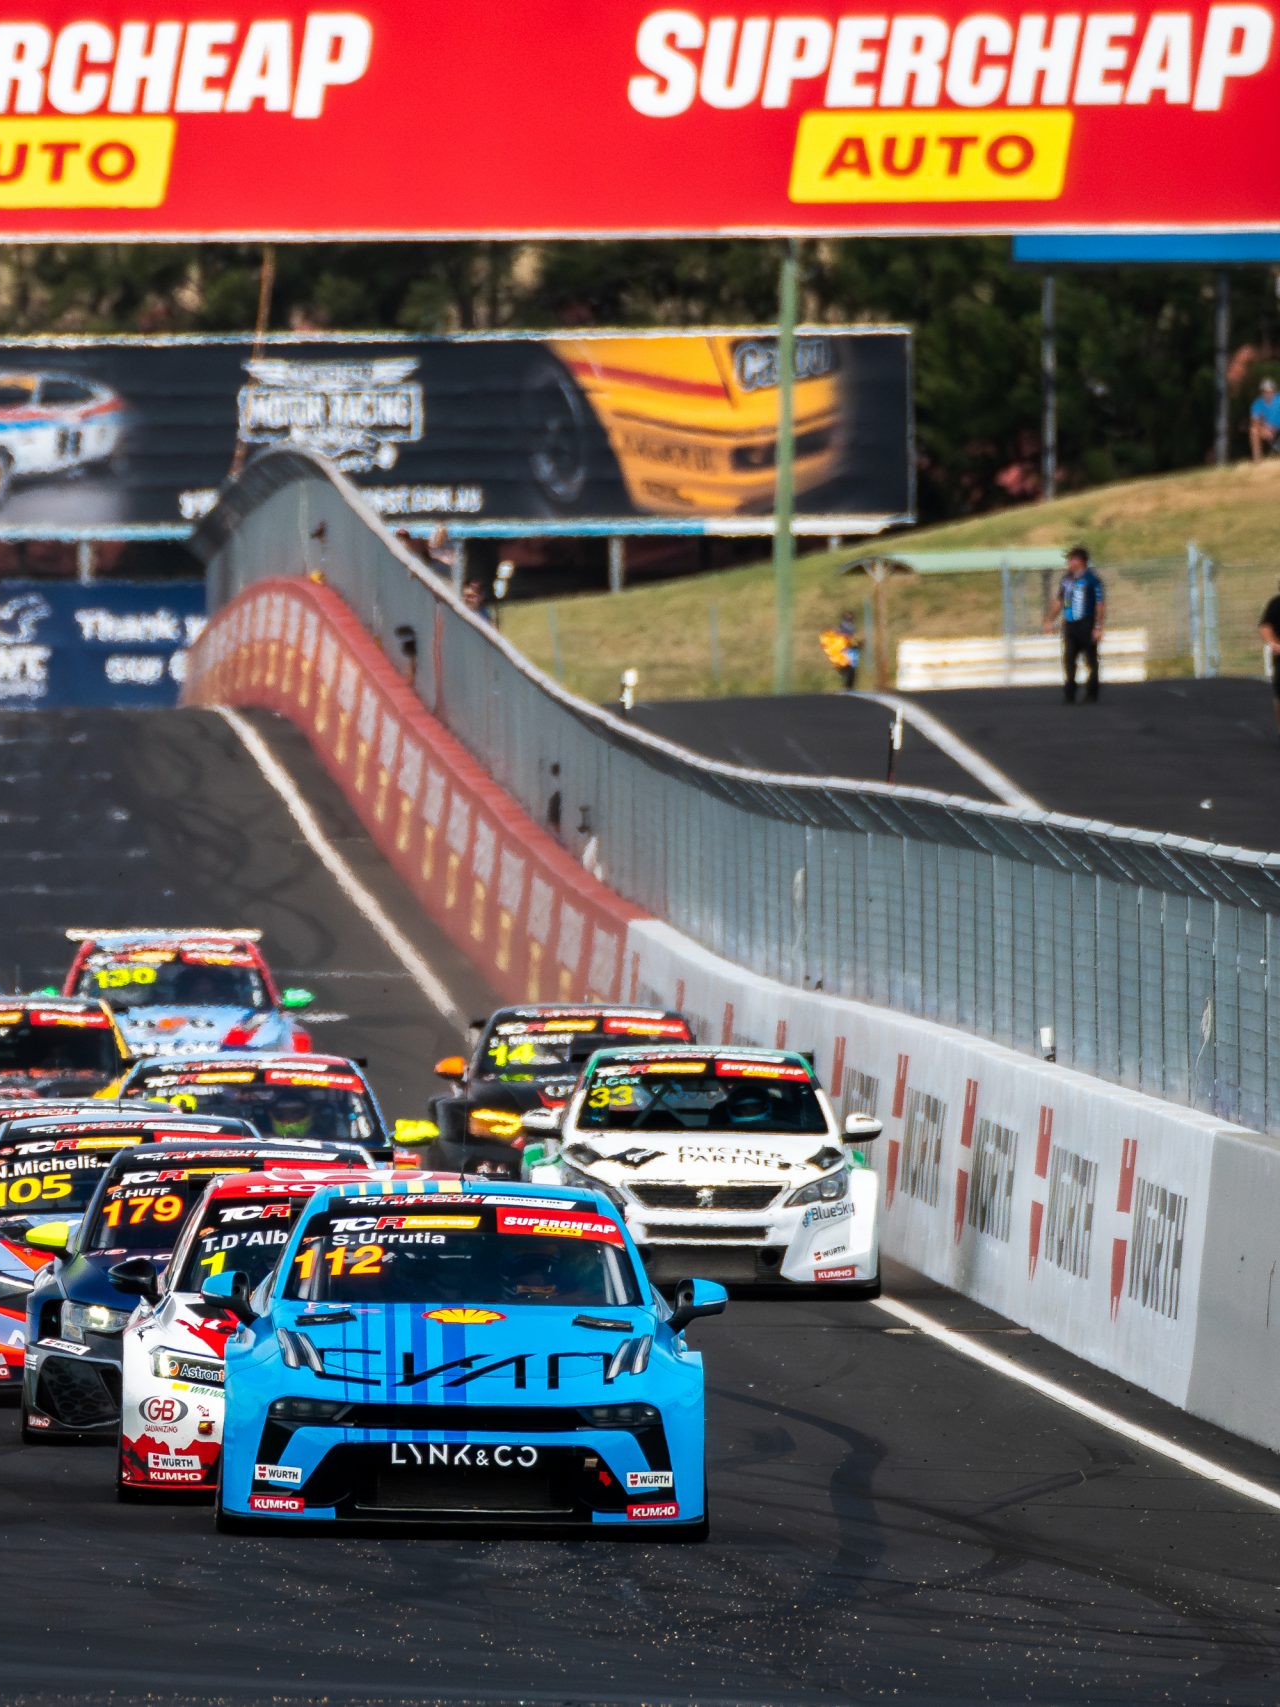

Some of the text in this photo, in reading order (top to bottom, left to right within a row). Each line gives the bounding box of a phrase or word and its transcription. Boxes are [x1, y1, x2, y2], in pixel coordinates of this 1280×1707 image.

[627, 4, 1272, 117] SUPERCHEAP
[824, 134, 1034, 178] AUTO
[488, 1043, 536, 1067] 14
[588, 1085, 633, 1108] 33
[15, 1139, 80, 1155] TCR
[678, 1145, 784, 1160] PITCHER
[120, 1169, 187, 1185] TCR
[112, 1188, 171, 1200] R.HUFF
[102, 1195, 184, 1228] 179
[219, 1204, 291, 1223] TCR
[811, 1202, 855, 1220] BlueSky
[329, 1217, 406, 1233] TCR
[504, 1217, 618, 1235] SUPERCHEAP
[332, 1232, 446, 1246] S.Urrutia
[295, 1244, 385, 1279] 112
[818, 1269, 852, 1278] KUMHO
[148, 1399, 175, 1421] GB
[150, 1471, 201, 1481] KUMHO
[254, 1499, 299, 1510] KUMHO
[632, 1506, 676, 1517] KUMHO
